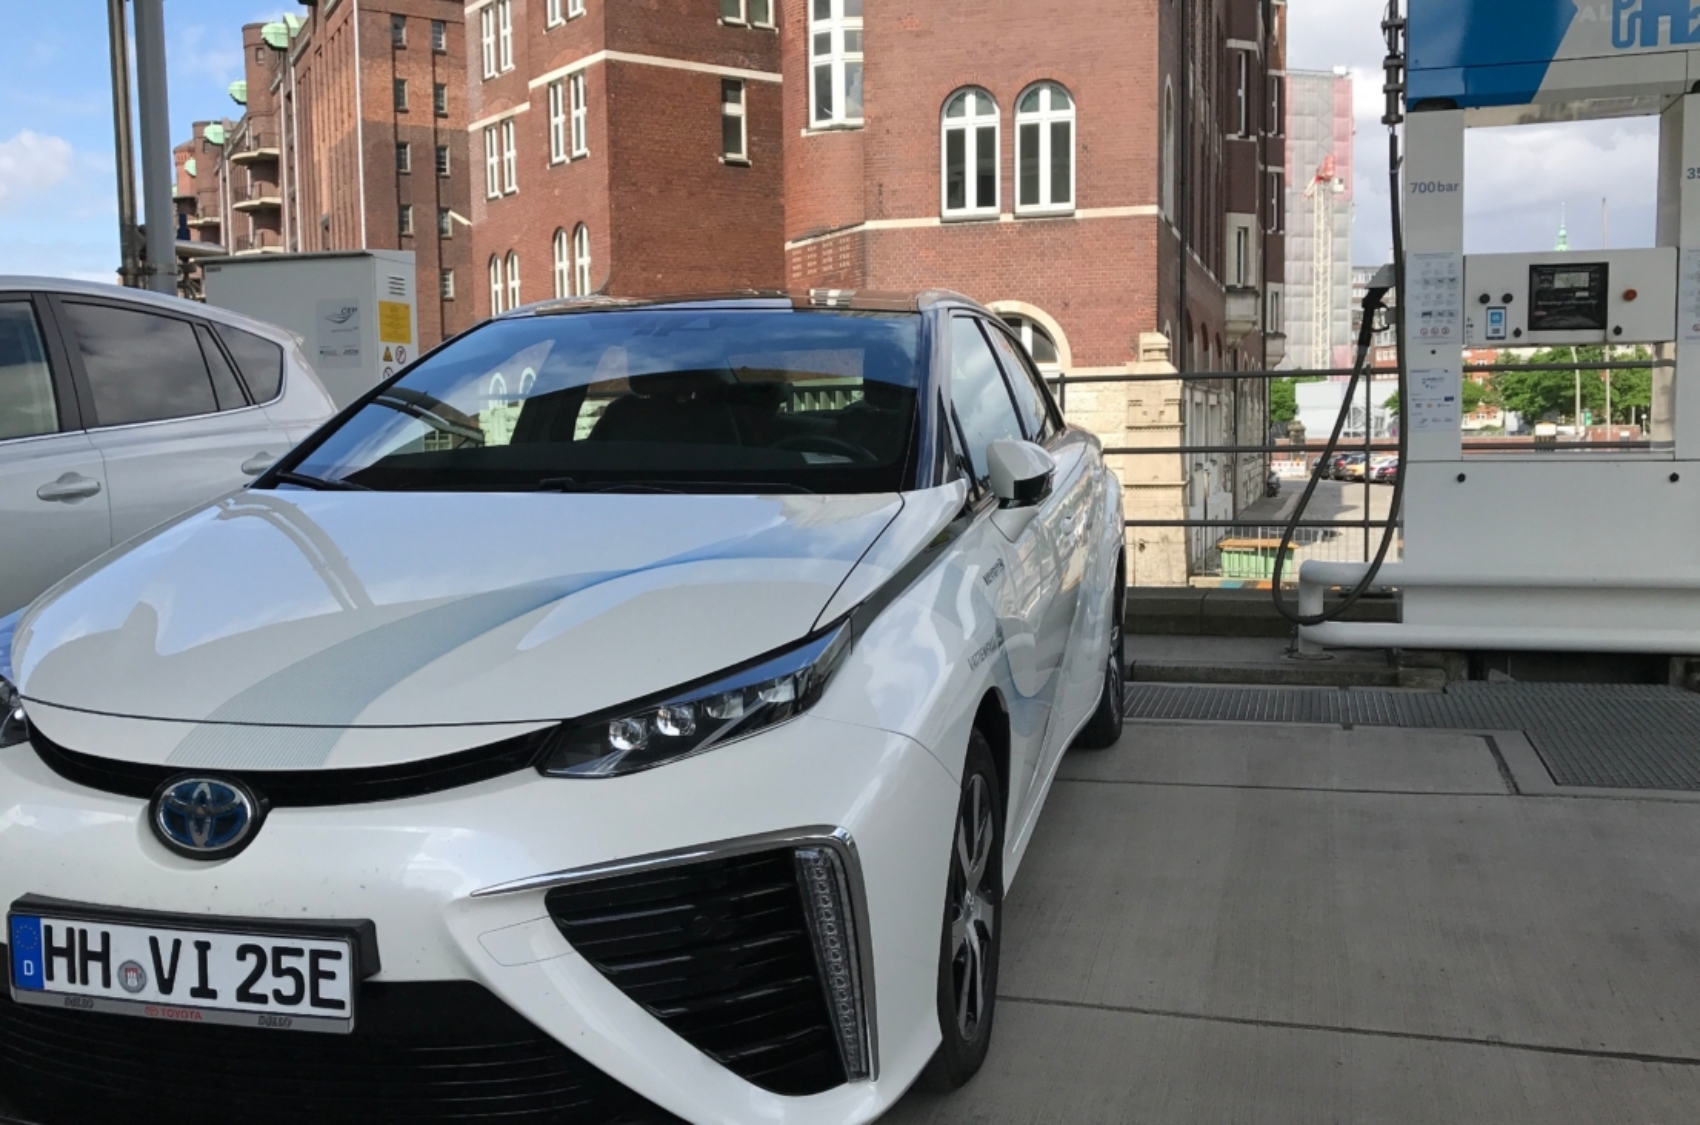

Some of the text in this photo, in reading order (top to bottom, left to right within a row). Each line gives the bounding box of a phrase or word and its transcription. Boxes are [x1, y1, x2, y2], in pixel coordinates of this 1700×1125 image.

[1409, 181, 1460, 194] 700 bar
[23, 960, 34, 976] D
[44, 924, 346, 1010] HH VI 25E
[161, 1008, 202, 1020] TOYOTA
